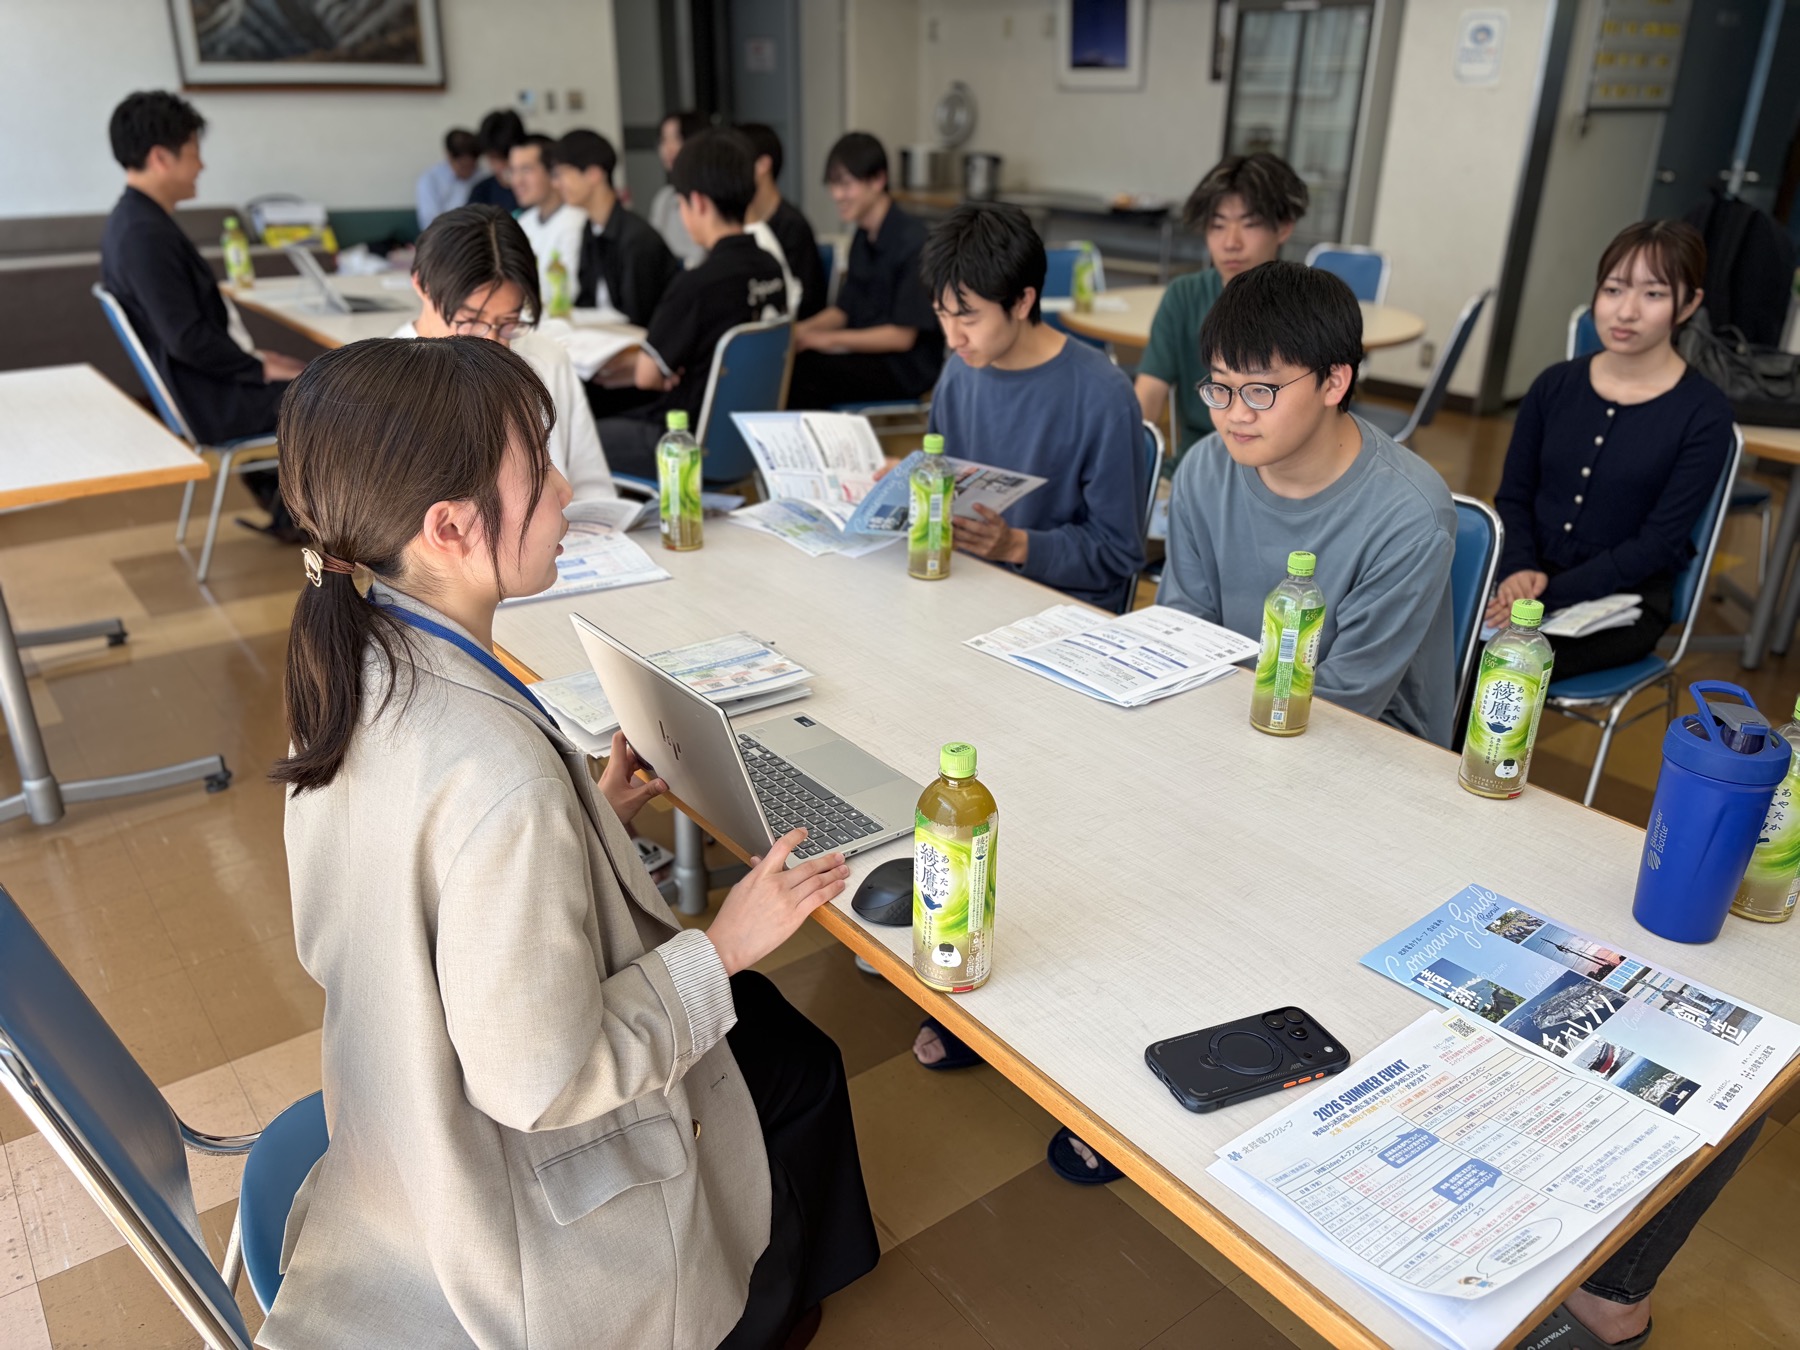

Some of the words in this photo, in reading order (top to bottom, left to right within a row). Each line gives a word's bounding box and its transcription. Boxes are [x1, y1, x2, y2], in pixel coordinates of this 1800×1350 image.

[1487, 681, 1516, 722] 綾鷹
[1511, 686, 1525, 720] あやたか
[1650, 809, 1663, 848] Blender
[1769, 788, 1792, 831] あやたか
[1656, 822, 1668, 853] Bottle
[920, 843, 940, 896] 綾鷹
[939, 855, 949, 896] あやたか
[1476, 903, 1501, 923] Recruit
[1385, 923, 1481, 986] Company
[1448, 885, 1498, 936] Guide
[1417, 968, 1482, 1010] 情熱
[1673, 1001, 1749, 1045] 創造
[1312, 1099, 1346, 1122] 2026
[1337, 1076, 1385, 1106] SUMMER
[1376, 1059, 1412, 1082] EVENT
[1721, 1082, 1744, 1103] 北陸電力
[1239, 1120, 1296, 1154] 北陸電力グループ
[1536, 1324, 1571, 1349] AIRWALK
